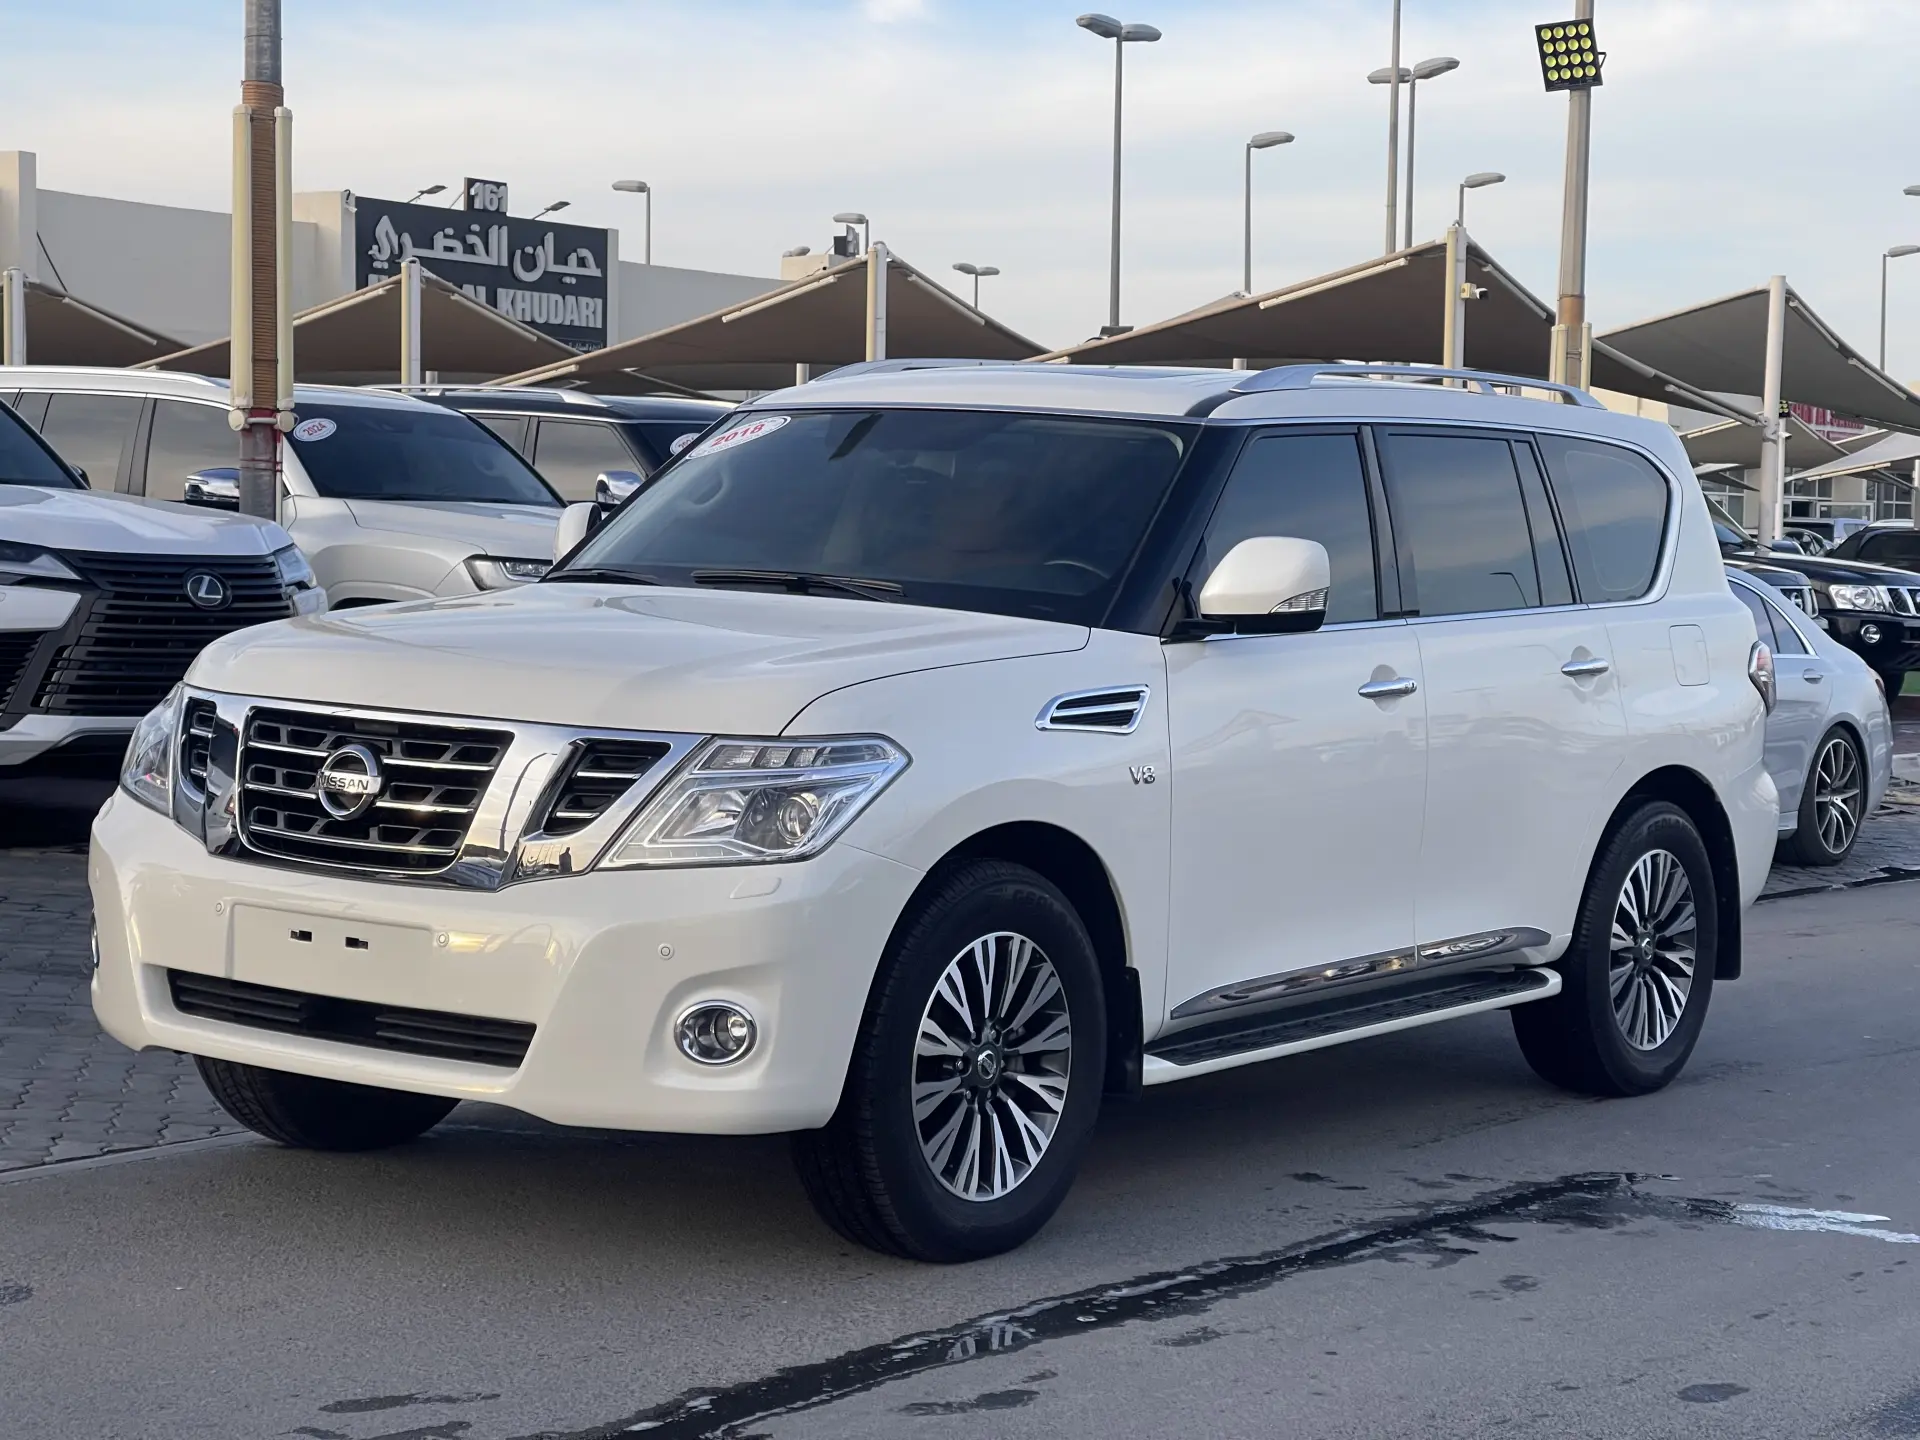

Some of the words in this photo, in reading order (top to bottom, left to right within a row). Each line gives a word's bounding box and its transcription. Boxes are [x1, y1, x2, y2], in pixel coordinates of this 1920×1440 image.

[470, 182, 508, 213] 161
[513, 231, 602, 284] حيان
[496, 287, 603, 329] KHUDARI
[711, 424, 765, 447] 2018
[319, 772, 369, 791] NISSAN
[1128, 765, 1156, 785] V8
